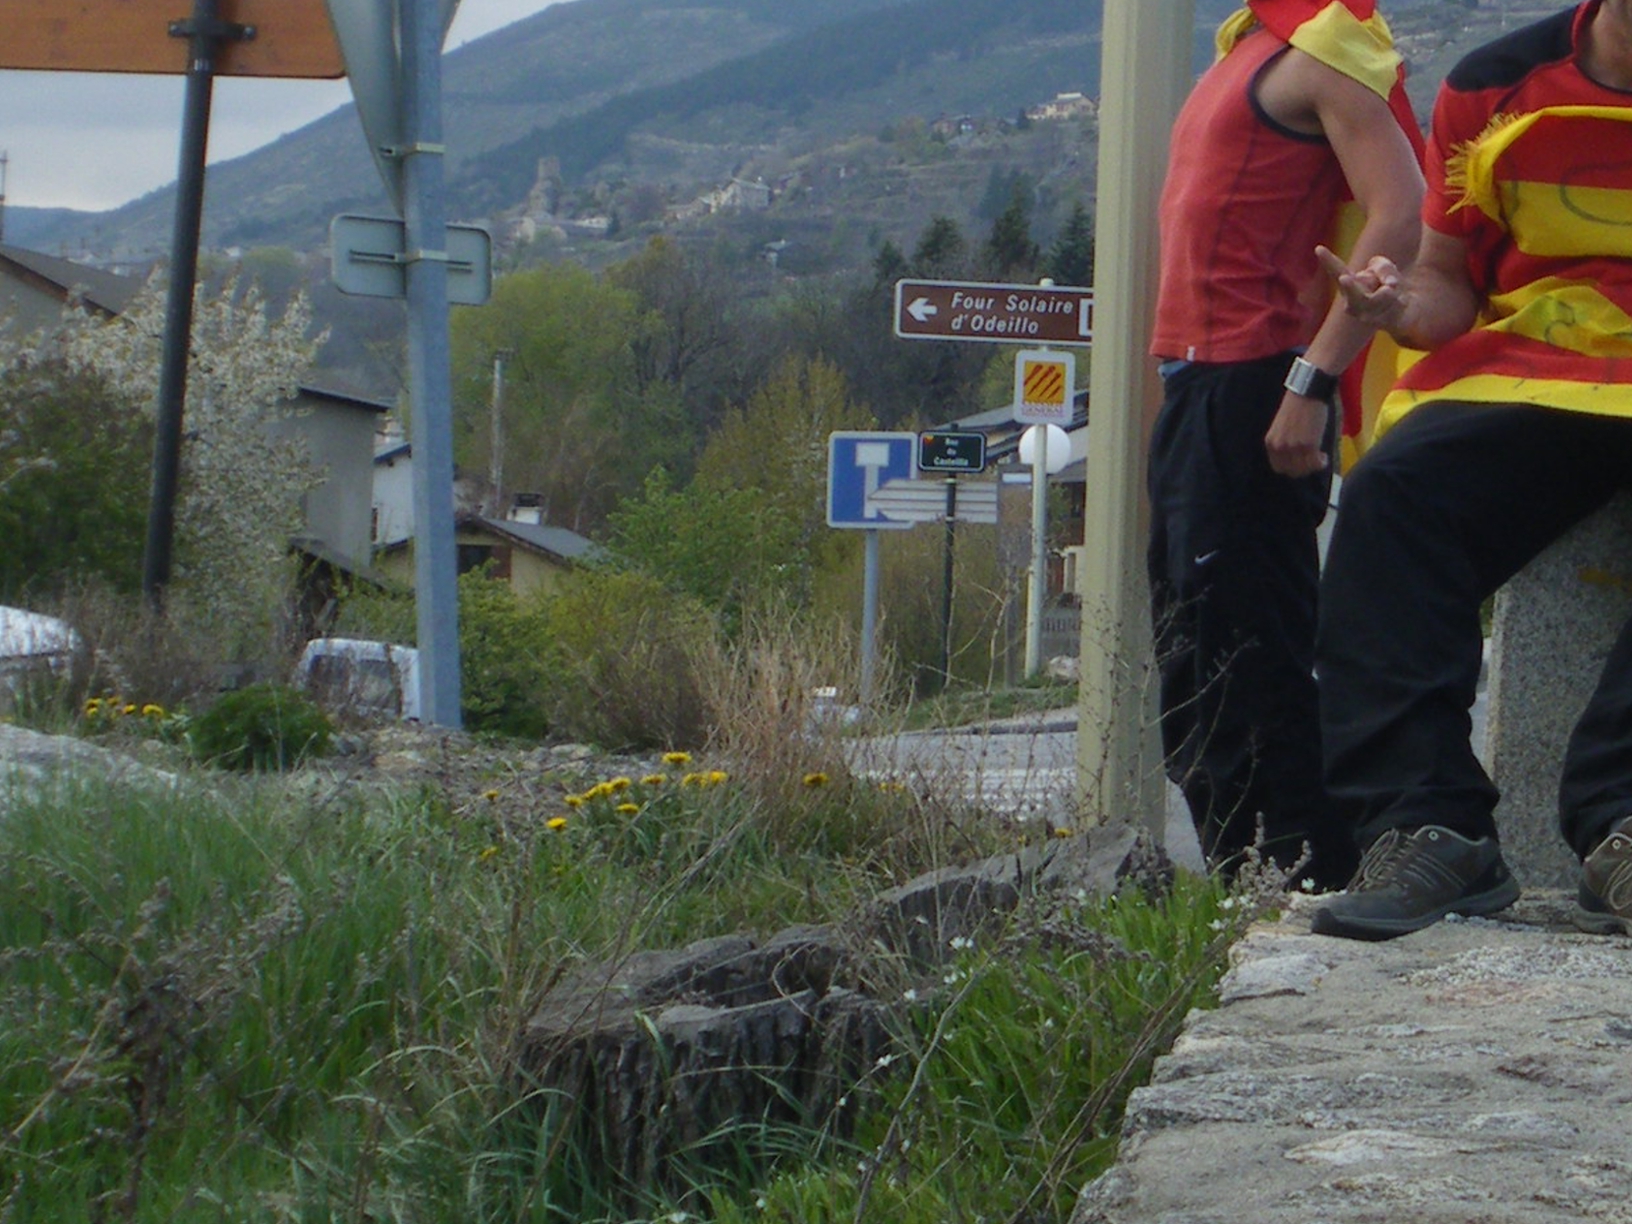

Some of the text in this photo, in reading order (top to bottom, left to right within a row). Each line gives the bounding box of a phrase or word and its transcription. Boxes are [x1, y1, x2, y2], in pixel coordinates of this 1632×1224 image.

[951, 291, 1074, 314] Four Solaire
[950, 313, 1040, 335] d'Odeillo
